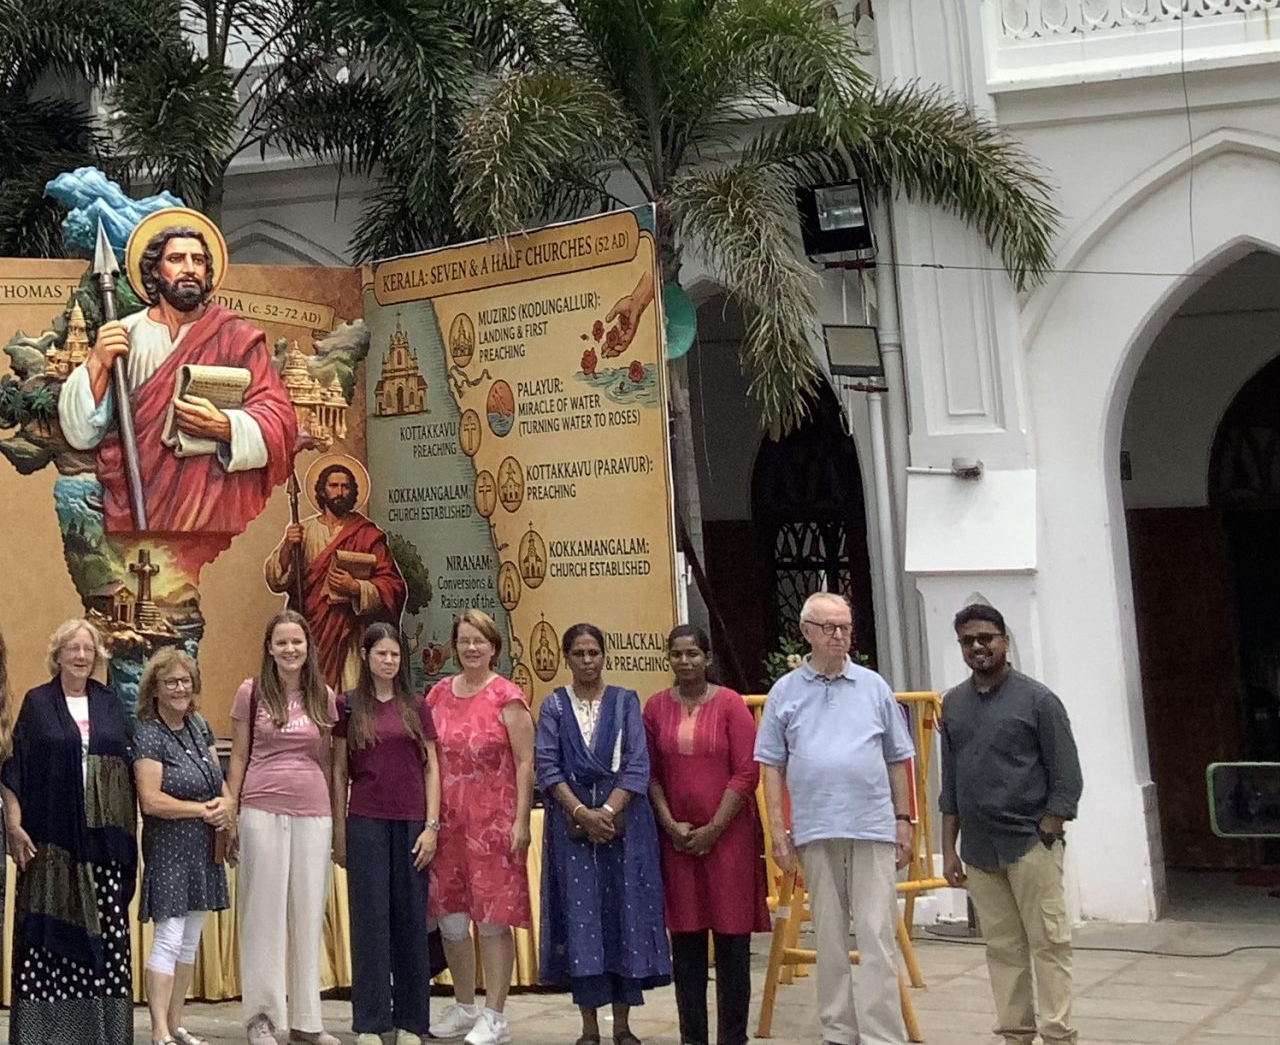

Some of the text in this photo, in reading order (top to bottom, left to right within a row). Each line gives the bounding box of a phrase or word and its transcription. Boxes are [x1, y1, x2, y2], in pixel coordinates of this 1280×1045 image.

[382, 230, 629, 294] KERALA: SEVEN & A HALF CHURCHES (52 AD)
[66, 285, 77, 299] T
[248, 302, 262, 314] (c.
[264, 304, 298, 320] 52-72
[300, 311, 322, 325] AD)
[478, 291, 601, 327] MUZIRIS (KODUNGALLUR):
[478, 321, 549, 345] LANDING & FIRST
[479, 345, 526, 364] PREACHING
[517, 377, 563, 398] PALAYUR:
[518, 394, 601, 417] MIRACLE OF WATER
[400, 422, 456, 441] KOTTAKKAVU
[518, 408, 641, 438] (TURNING WATER TO ROSES)
[413, 442, 457, 458] PREACHING
[526, 454, 654, 482] KOTTAKKAVU (PARAVUR):
[527, 483, 577, 501] PREACHING
[388, 504, 472, 522] CHURCH ESTABLISHED
[549, 538, 650, 558] KOKKAMANGALAM:
[446, 554, 493, 571] NIRANAM:
[550, 560, 651, 578] CHURCH ESTABLISHED
[438, 575, 495, 590] Conversions &
[441, 594, 495, 610] Raising of the
[605, 656, 670, 672] & PREACHING
